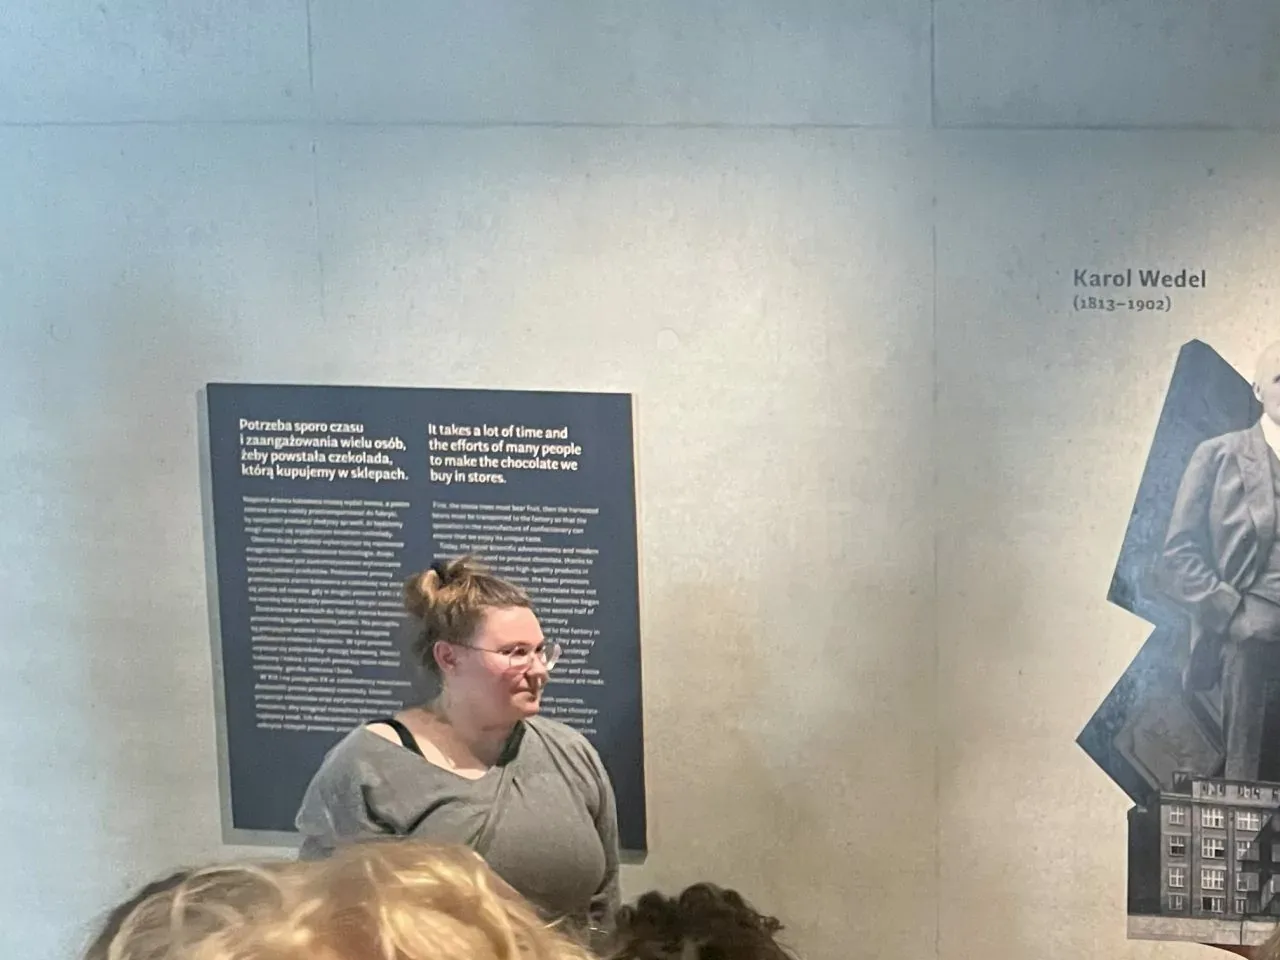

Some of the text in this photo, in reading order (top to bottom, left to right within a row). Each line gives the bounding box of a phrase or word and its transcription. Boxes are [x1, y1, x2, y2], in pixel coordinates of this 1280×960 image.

[1073, 268, 1206, 288] Karol Wedel
[239, 418, 364, 435] Potrzeba sporo czasu
[428, 423, 568, 439] It takes a lot of time and
[246, 434, 339, 450] zaangażowania
[340, 435, 372, 449] wielu
[374, 436, 407, 452] osób,
[429, 438, 582, 459] the efforts of many people
[241, 448, 268, 465] żeby
[328, 450, 394, 466] czekolada,
[429, 454, 578, 471] to make the chocolate we
[241, 463, 409, 483] którą kupujemy w sklepach.
[430, 468, 507, 486] buy in stores.
